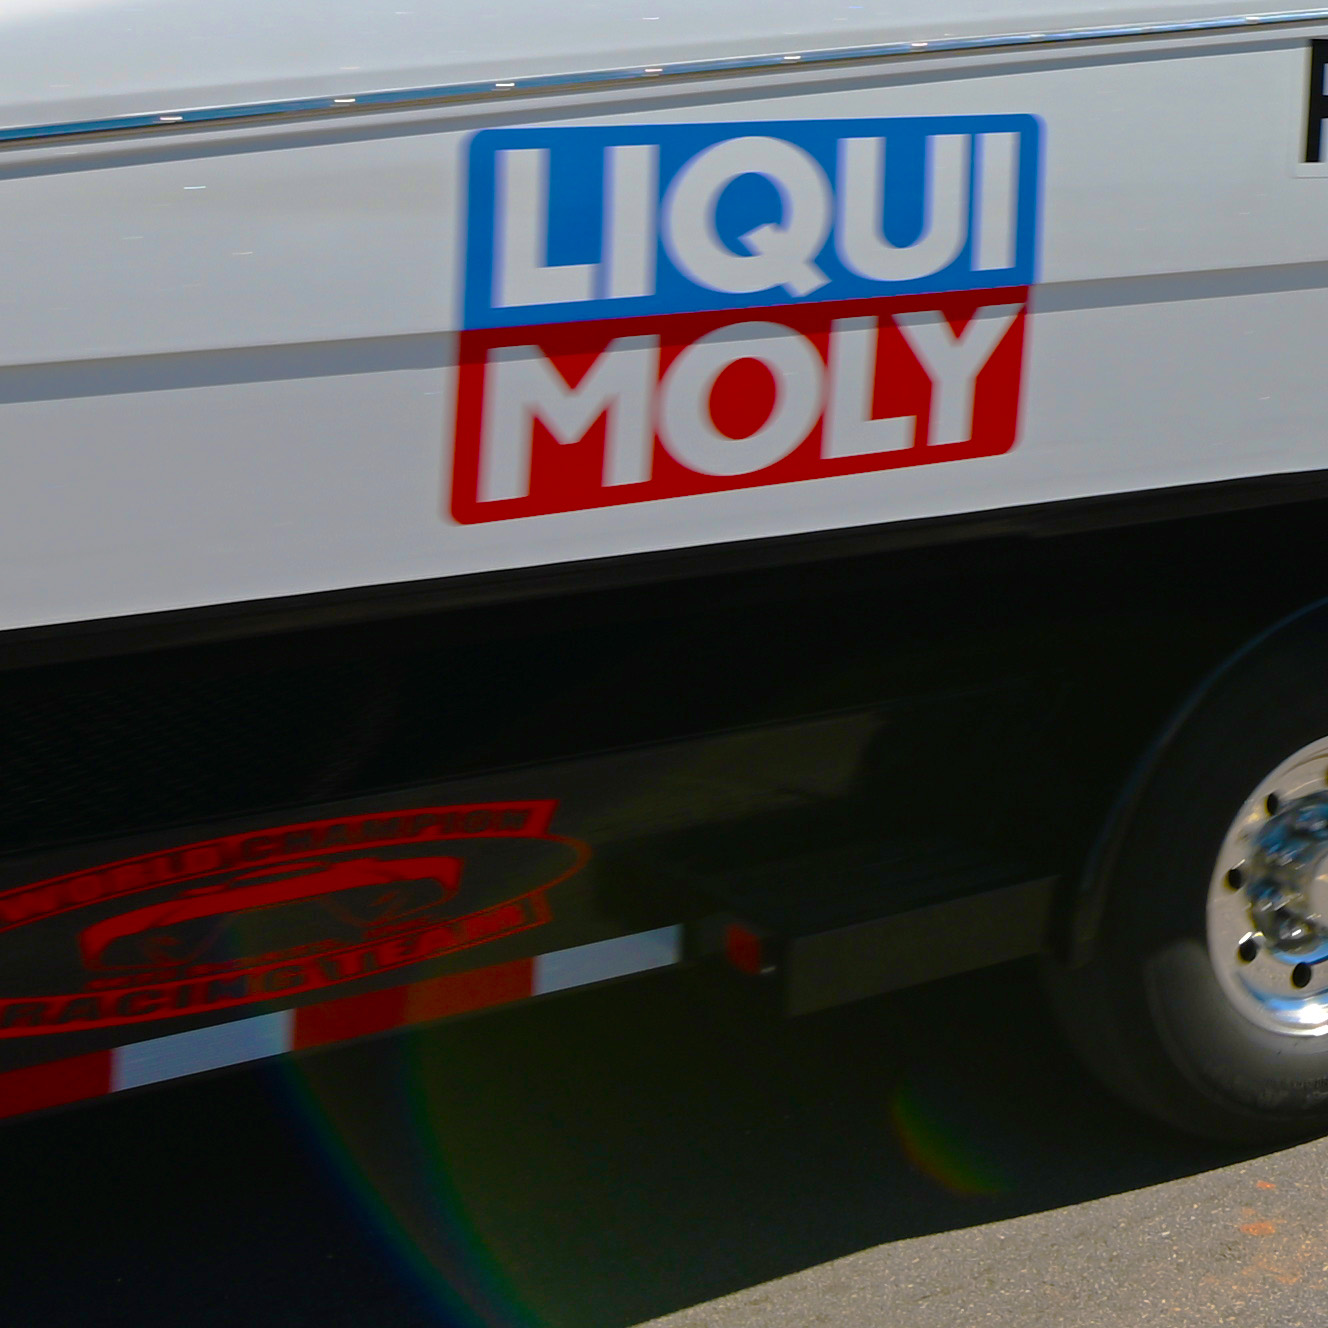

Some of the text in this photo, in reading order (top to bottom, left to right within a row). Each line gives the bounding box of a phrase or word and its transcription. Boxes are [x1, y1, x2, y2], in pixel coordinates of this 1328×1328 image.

[490, 131, 1021, 309] LIQUI
[475, 302, 1027, 504] MOLY
[240, 807, 533, 862] CHAMPION
[2, 964, 304, 1027] RACING
